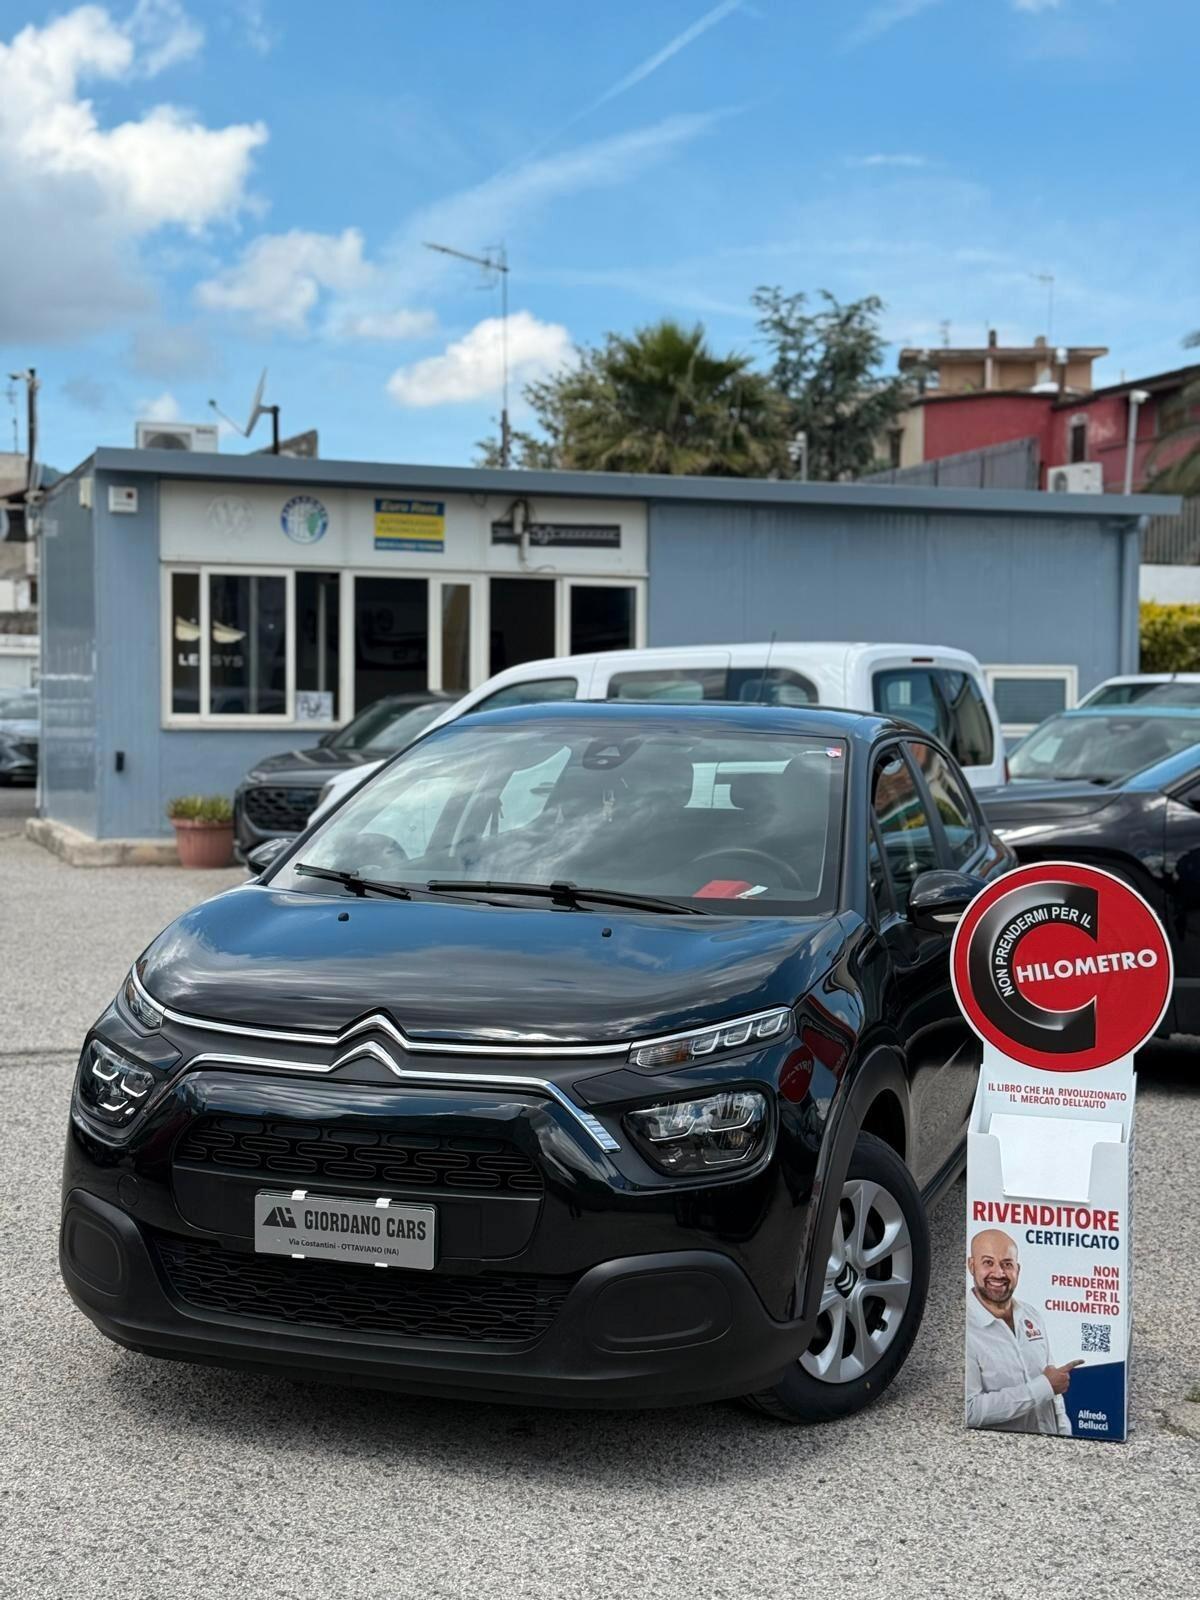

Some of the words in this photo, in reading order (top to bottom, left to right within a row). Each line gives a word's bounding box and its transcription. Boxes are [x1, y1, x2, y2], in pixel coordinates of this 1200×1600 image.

[178, 653, 243, 668] LESYS
[1051, 906, 1080, 922] PER
[1080, 912, 1092, 929] IL
[995, 907, 1048, 967] PRENDERMI
[995, 970, 1015, 997] NON
[988, 1083, 995, 1092] IL
[997, 1083, 1022, 1094] LIBRO
[1024, 1085, 1040, 1095] CHE
[1043, 1087, 1055, 1096] HA
[1058, 1087, 1127, 1102] RIVOLUZIONATO
[1010, 1094, 1017, 1103] IL
[1020, 1094, 1060, 1106] MERCATO
[1063, 1097, 1106, 1109] DELL'AUTO
[304, 1209, 381, 1237] GIORDANO
[386, 1217, 427, 1241] CARS
[973, 1201, 1120, 1232] RIVENDITORE
[289, 1238, 300, 1246] Via
[301, 1239, 336, 1250] Costantini
[341, 1242, 383, 1255] OTTAVIANO
[384, 1246, 400, 1257] (NA)
[1025, 1229, 1120, 1251] CERTIFICATO
[1093, 1265, 1120, 1278] NON
[1051, 1275, 1120, 1291] PRENDERMI
[1085, 1290, 1107, 1302] PER
[1109, 1292, 1120, 1304] IL
[1045, 1299, 1120, 1316] CHILOMETRO
[1078, 1410, 1107, 1421] Alfredo
[1078, 1420, 1109, 1431] Bellucci
